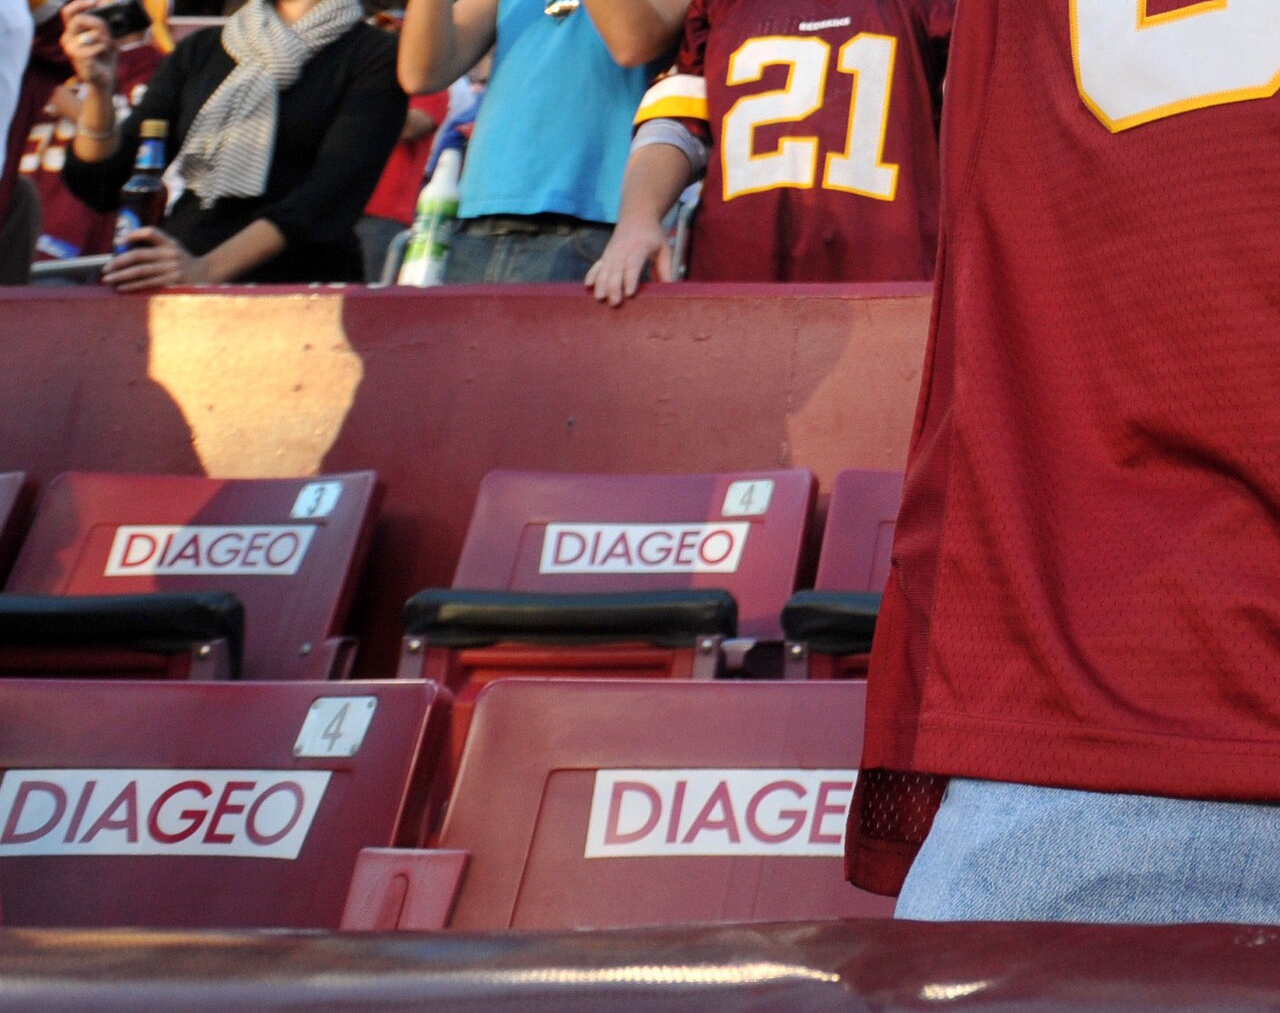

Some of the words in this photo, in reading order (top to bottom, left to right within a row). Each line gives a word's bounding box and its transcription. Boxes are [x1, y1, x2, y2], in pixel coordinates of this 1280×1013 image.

[722, 31, 900, 202] 21
[738, 484, 757, 513] 4
[119, 531, 300, 568] DIAGEO
[552, 529, 734, 567] DIAGEO
[321, 701, 350, 752] 4
[0, 779, 305, 847] DIAGEO
[603, 779, 854, 846] DIAGE
